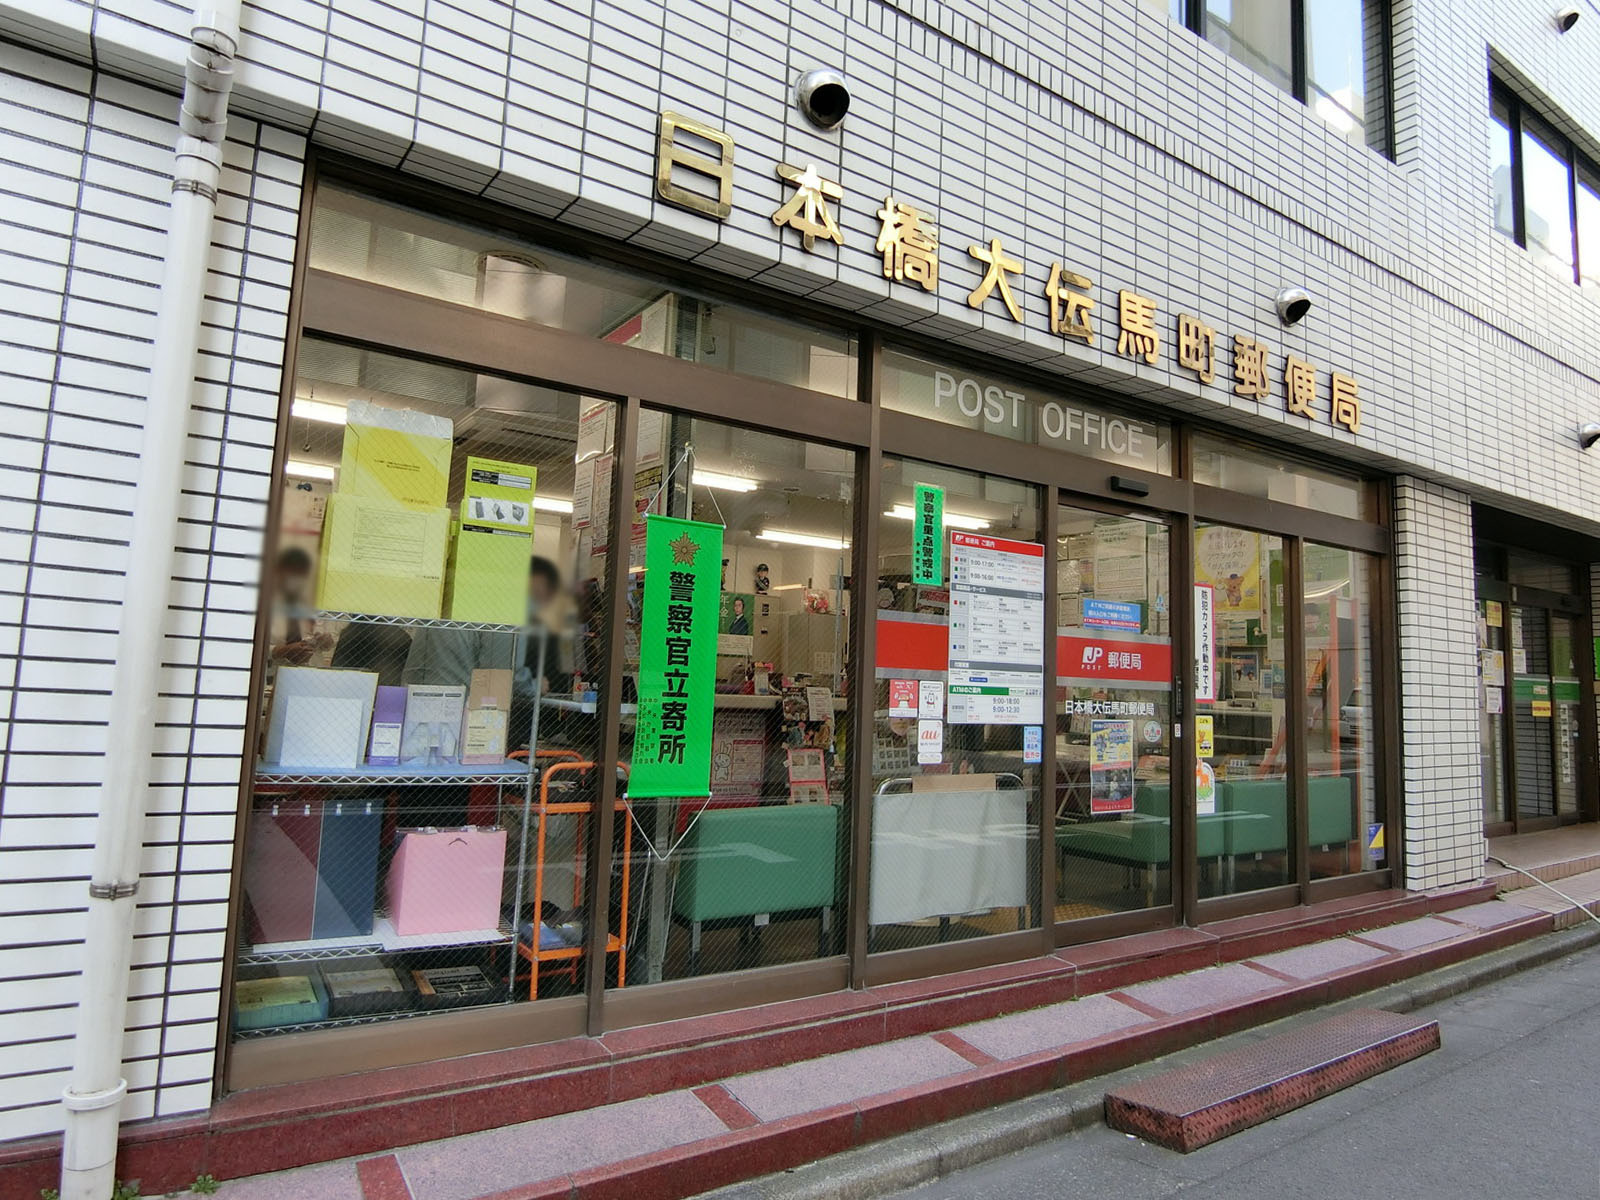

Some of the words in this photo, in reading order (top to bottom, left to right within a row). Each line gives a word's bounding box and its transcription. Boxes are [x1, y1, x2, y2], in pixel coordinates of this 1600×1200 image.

[657, 109, 1360, 434] 日本橋大伝馬町郵便局
[934, 370, 1025, 428] POST
[1042, 402, 1143, 457] OFFICE
[657, 571, 696, 764] 警察官立寄所
[1082, 646, 1103, 664] JP
[1107, 651, 1142, 670] 郵便局
[1201, 589, 1209, 696] 防犯カメラ作動中です
[1065, 700, 1155, 716] 日本橋大伝馬町郵便局
